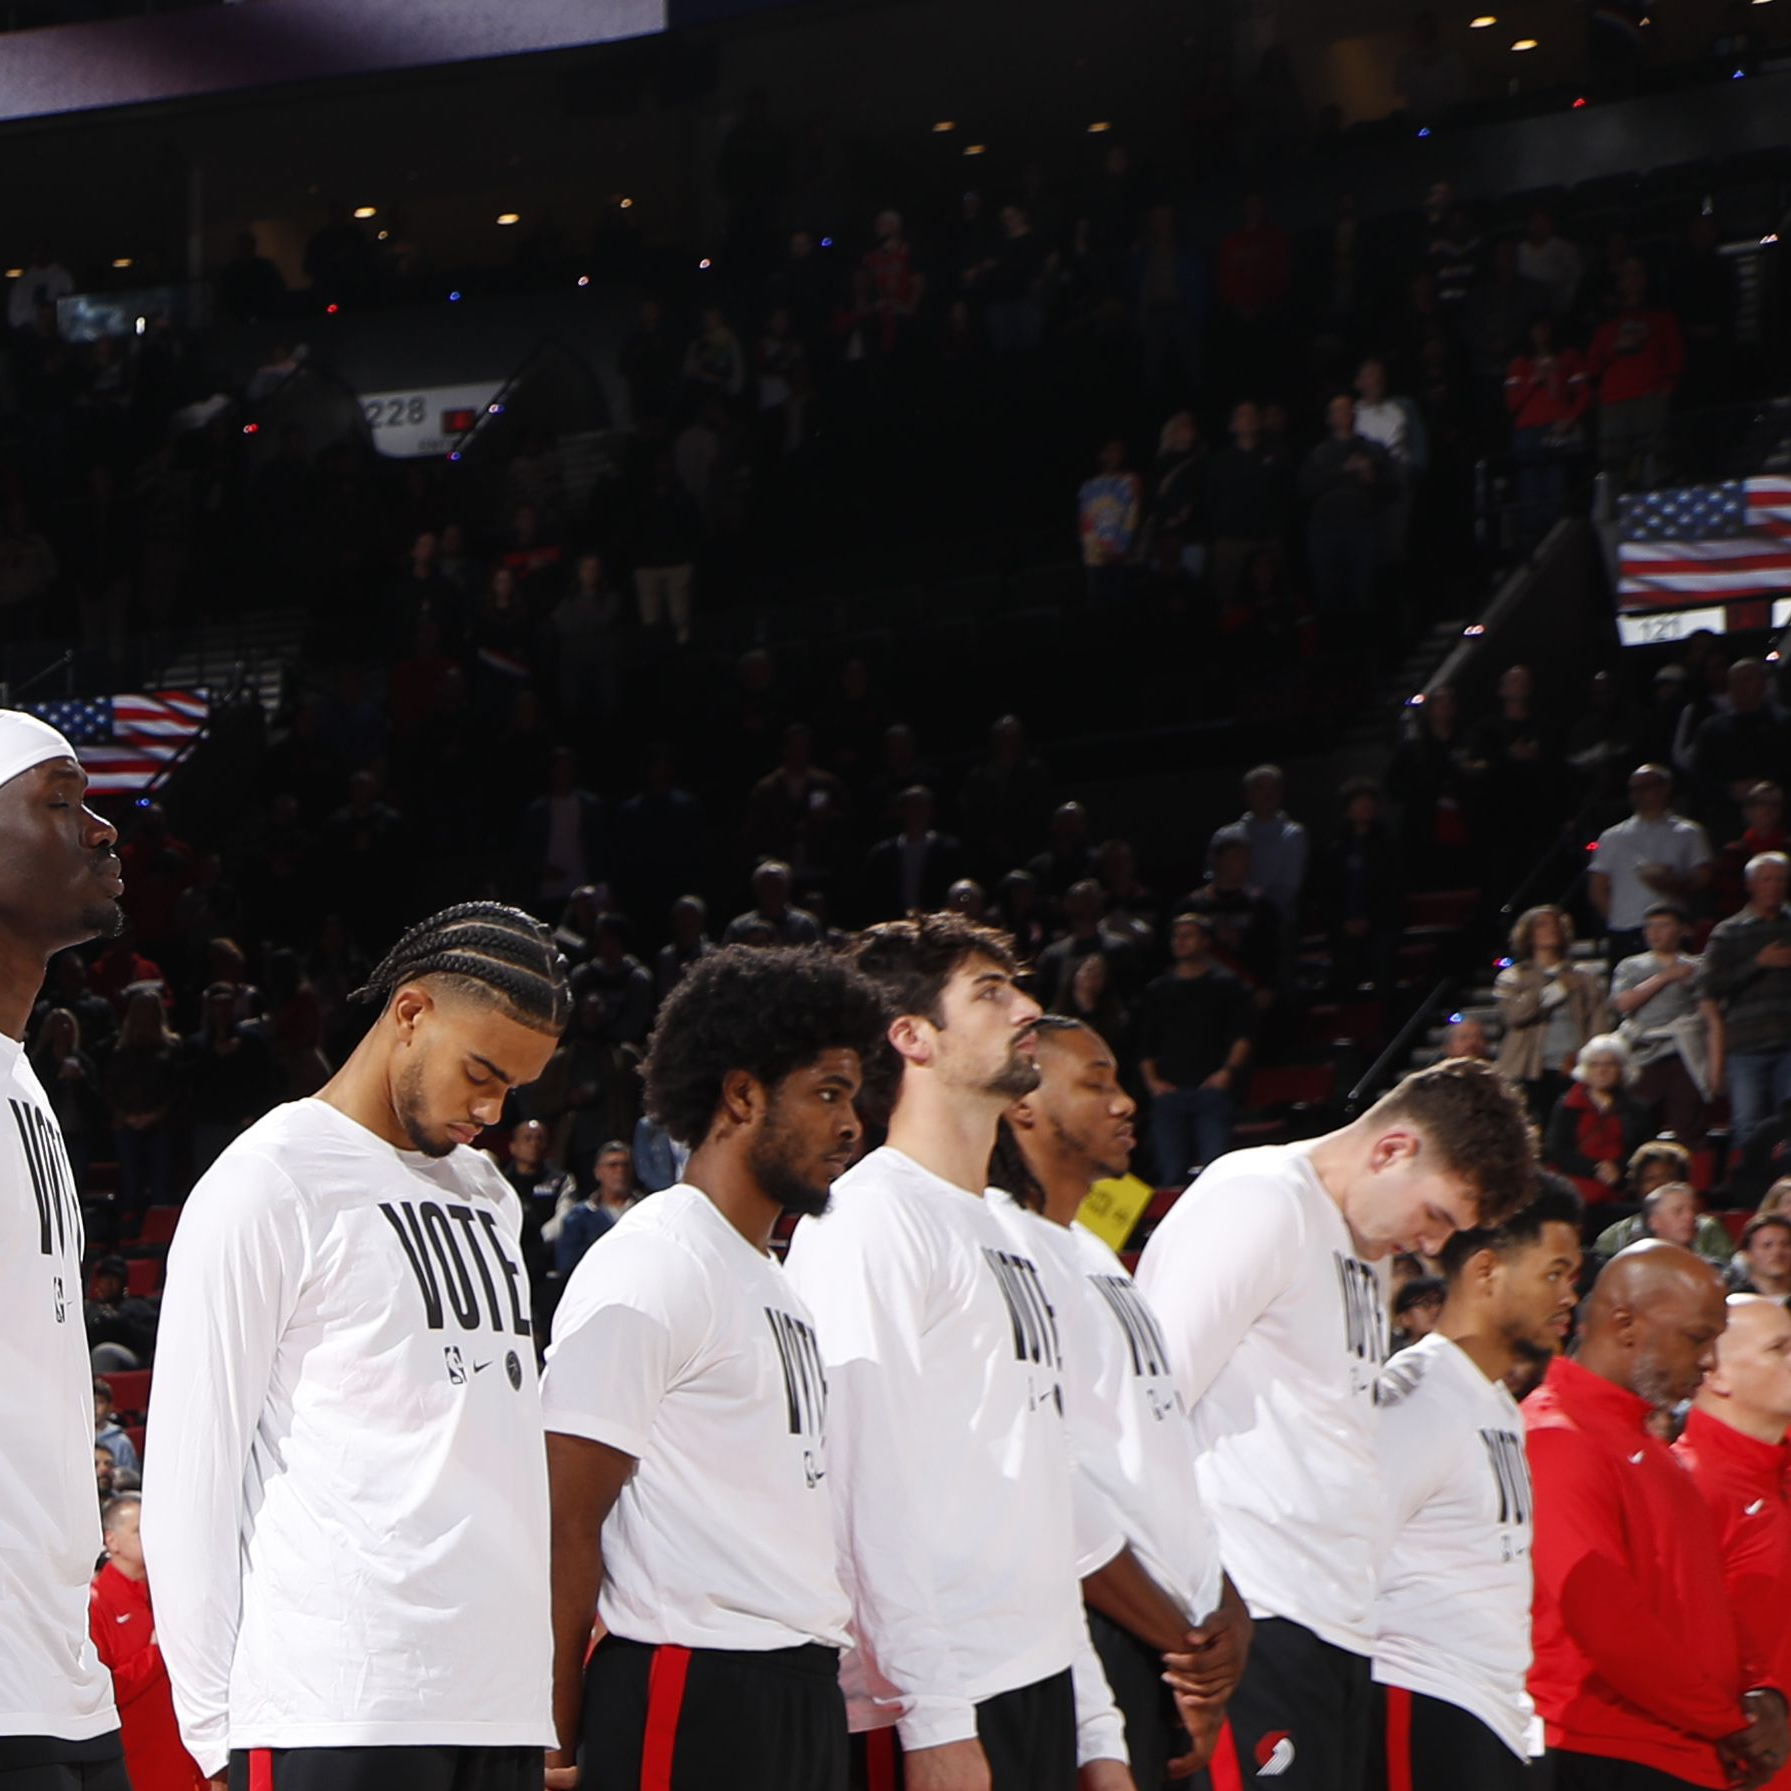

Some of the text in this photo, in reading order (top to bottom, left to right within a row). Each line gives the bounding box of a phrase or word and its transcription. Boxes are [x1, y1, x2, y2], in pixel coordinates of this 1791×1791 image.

[365, 397, 425, 427] 228
[1639, 618, 1679, 642] 121
[377, 1201, 531, 1337] VOTE
